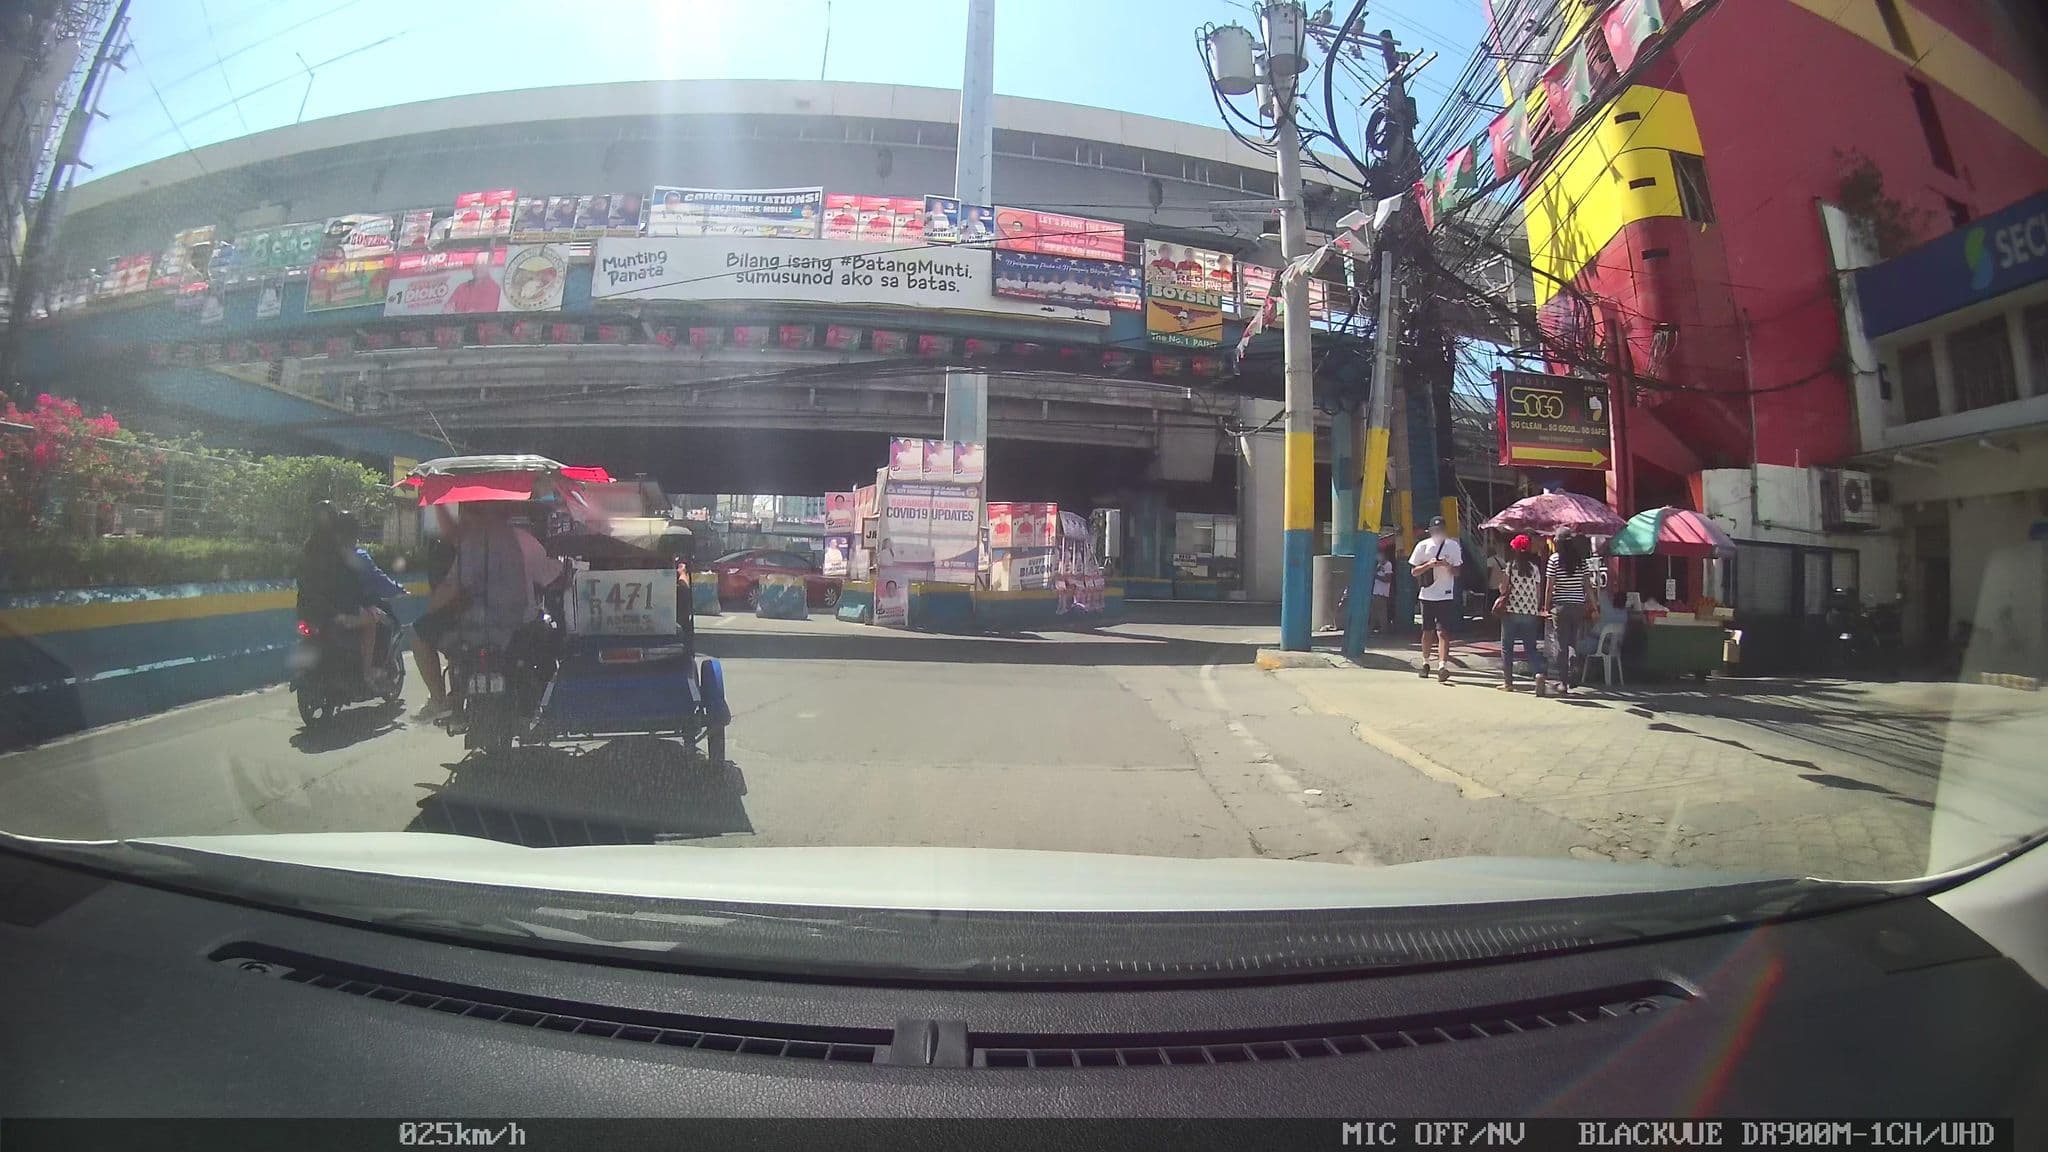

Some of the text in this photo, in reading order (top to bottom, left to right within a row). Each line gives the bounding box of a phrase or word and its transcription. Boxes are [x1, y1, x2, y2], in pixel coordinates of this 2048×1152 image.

[684, 191, 820, 205] CONGRATULATIONS!
[602, 250, 668, 272] Munting
[726, 252, 972, 279] Bilang isang #BatangMunti.
[608, 264, 664, 286] Panata
[736, 270, 960, 293] sumusunod ako sa batas.
[1151, 285, 1220, 307] BOYSEN
[1151, 332, 1167, 343] The
[1510, 386, 1564, 419] SOGO
[1549, 424, 1558, 432] SO
[1581, 426, 1590, 434] SO
[886, 507, 974, 521] COVID19 UPDATES
[1019, 563, 1053, 577] BIAZON
[605, 582, 653, 612] 471
